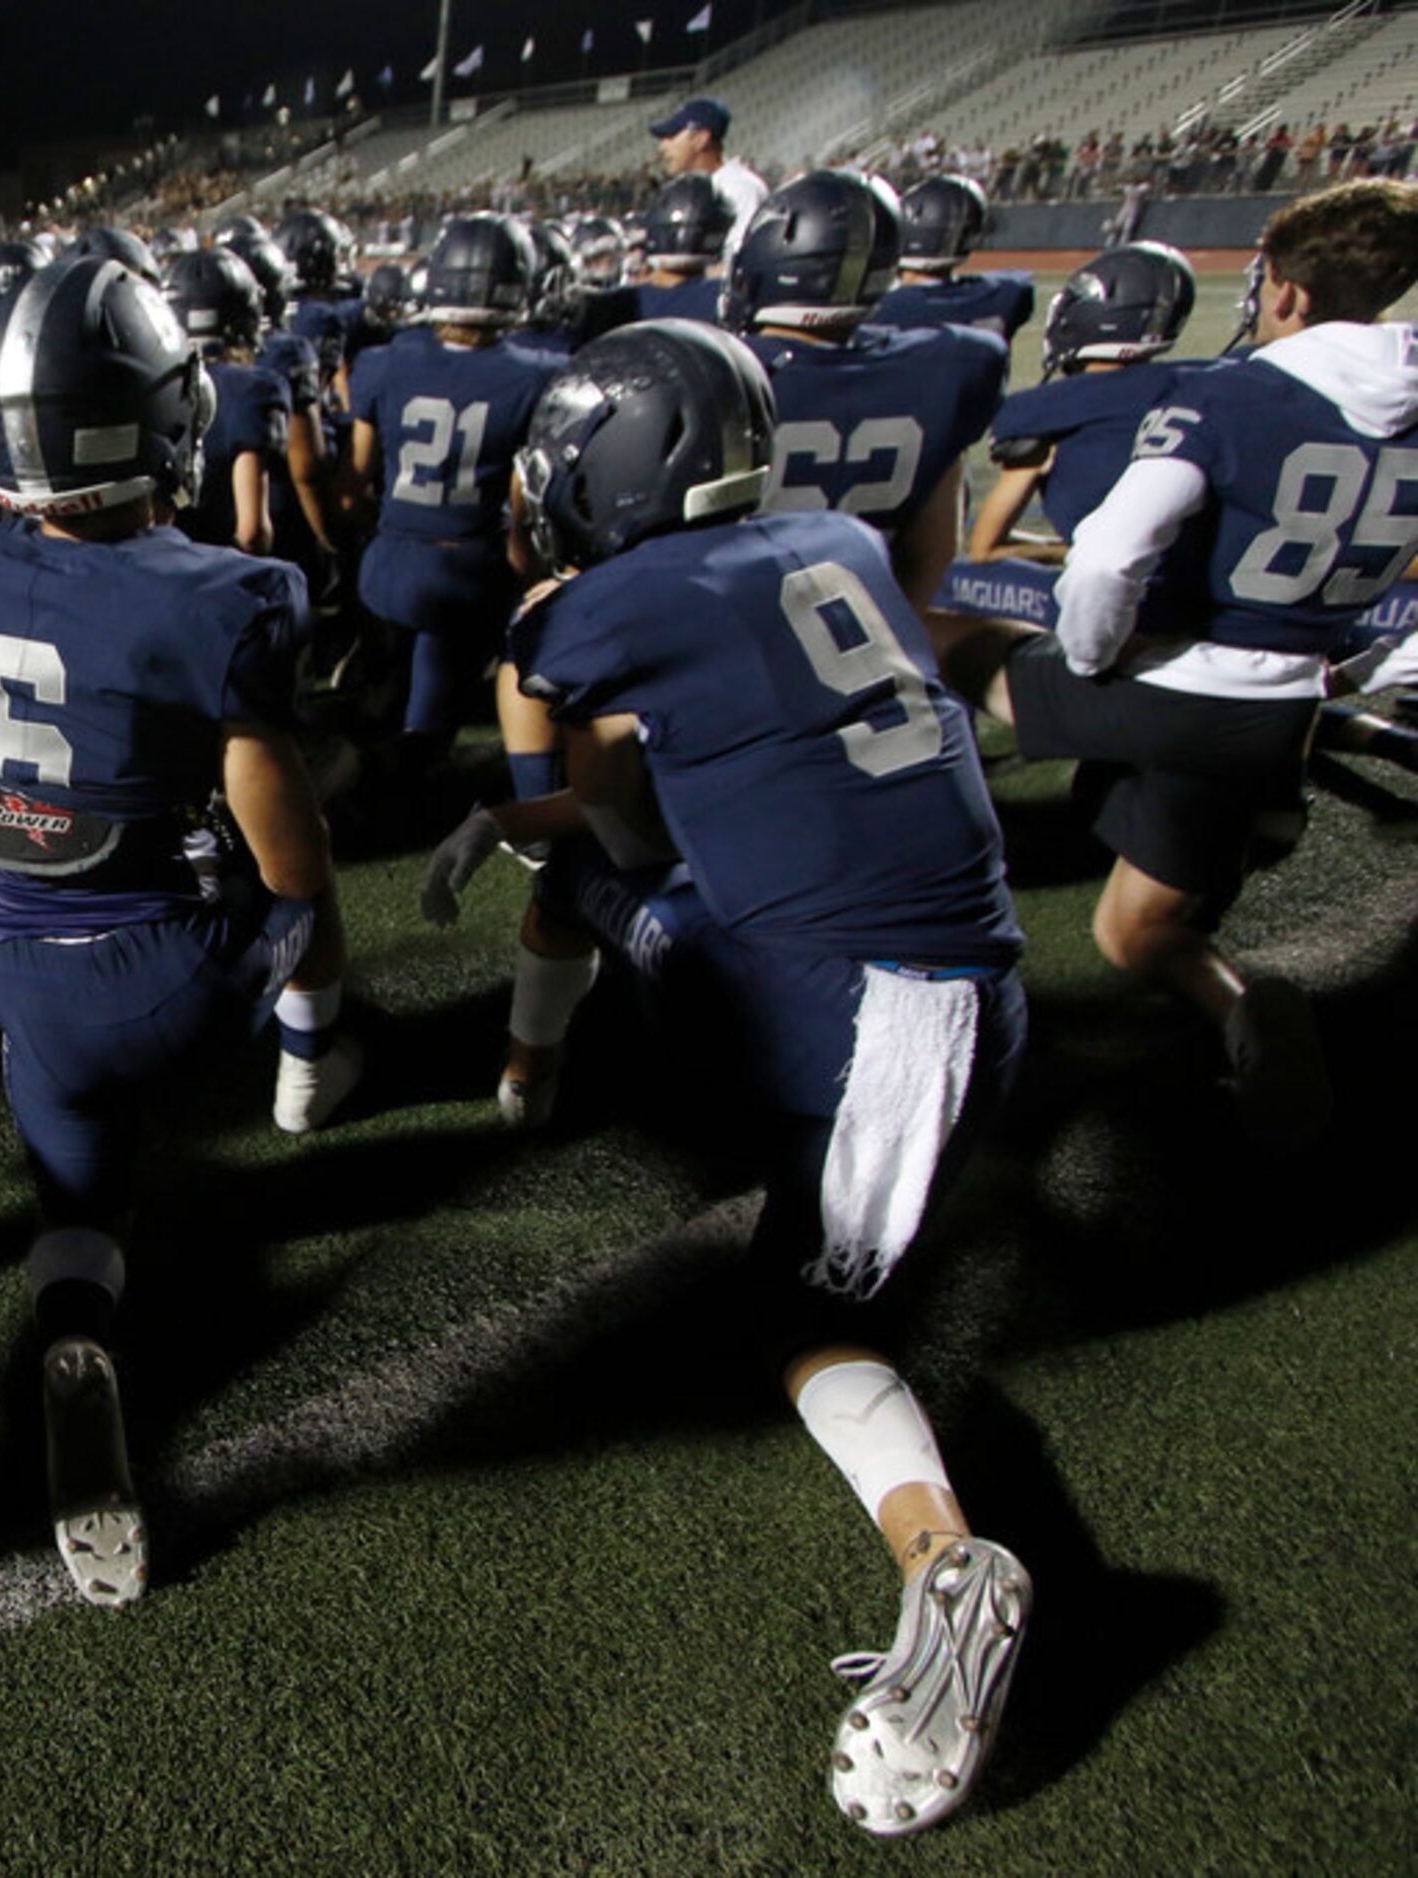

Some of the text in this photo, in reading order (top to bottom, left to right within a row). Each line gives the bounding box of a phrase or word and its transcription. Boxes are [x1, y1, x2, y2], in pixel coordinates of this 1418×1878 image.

[391, 395, 489, 507] 21
[1228, 442, 1418, 607] 85
[780, 561, 942, 777] 9
